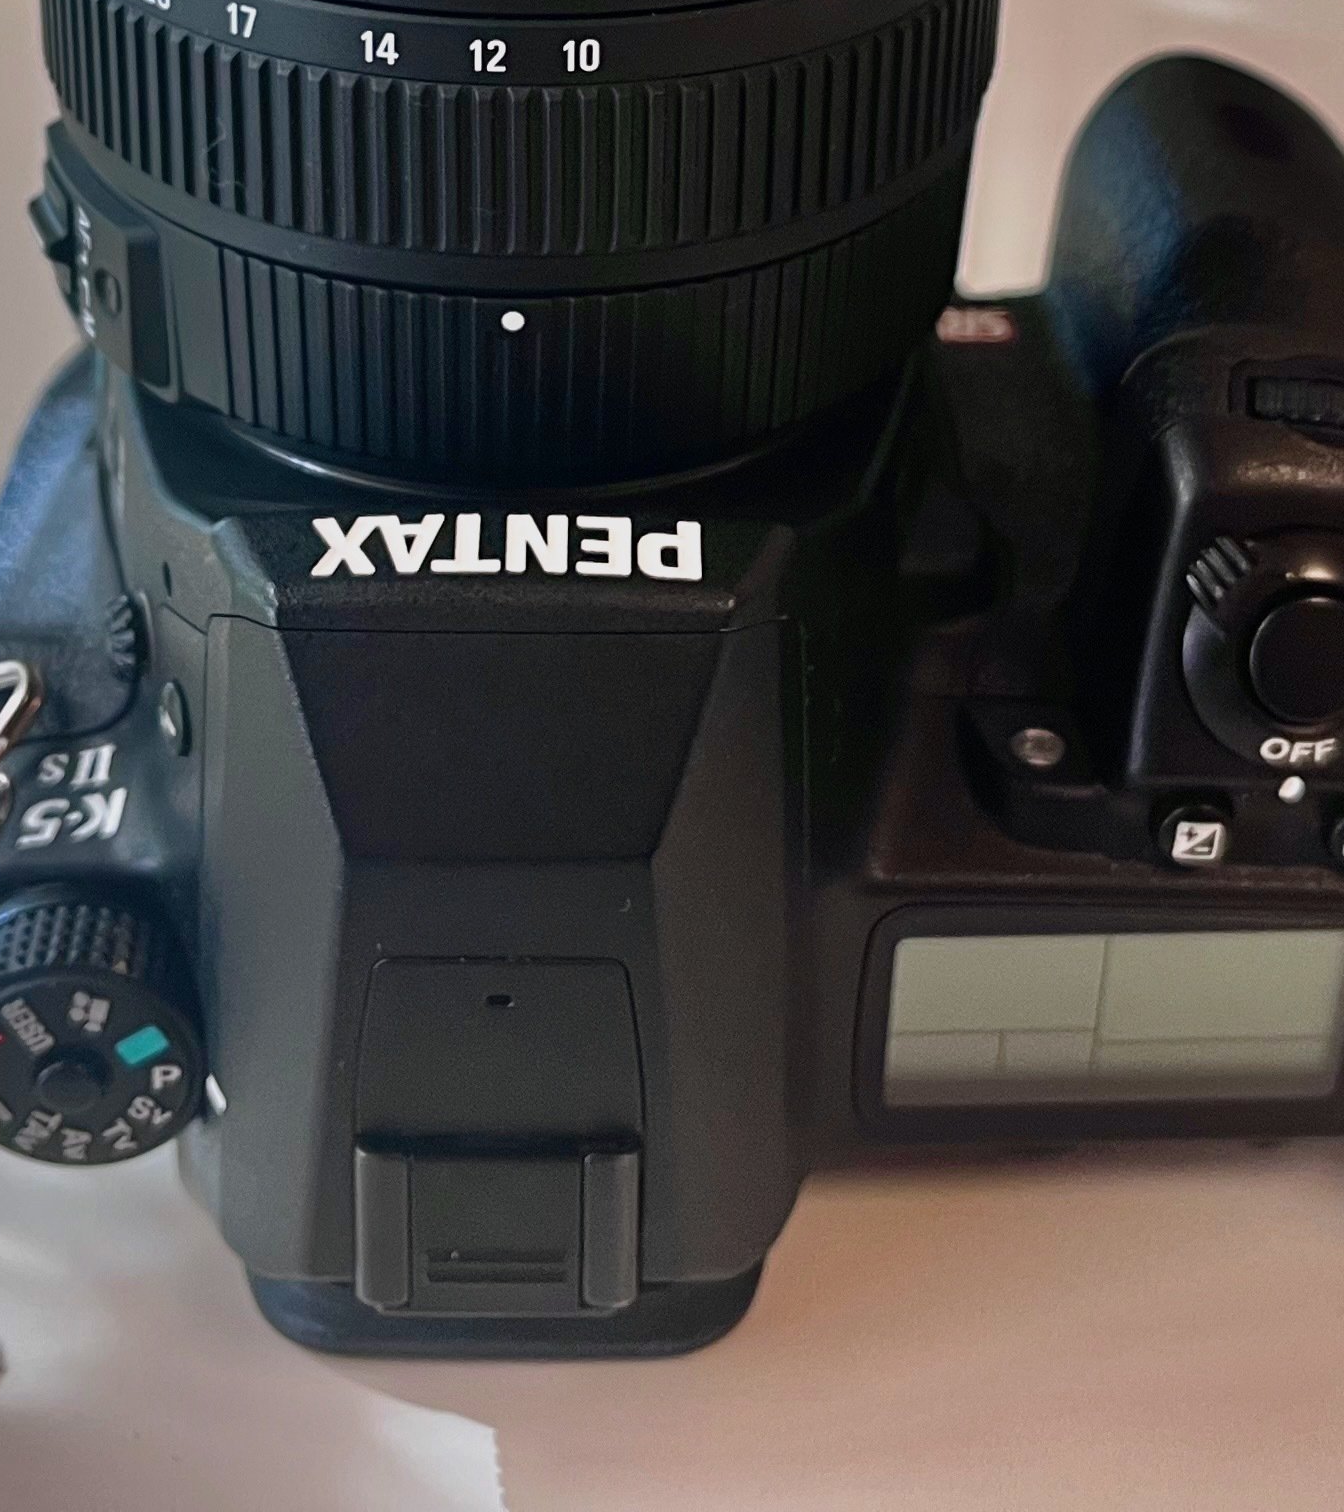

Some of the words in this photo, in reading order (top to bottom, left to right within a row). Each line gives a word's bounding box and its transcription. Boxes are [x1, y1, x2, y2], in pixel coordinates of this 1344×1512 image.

[226, 2, 257, 38] 17
[360, 30, 400, 65] 14
[469, 39, 507, 73] 12
[562, 39, 601, 73] 10
[310, 513, 703, 581] PENTAX
[1260, 737, 1337, 764] OFF
[151, 1064, 183, 1090] P
